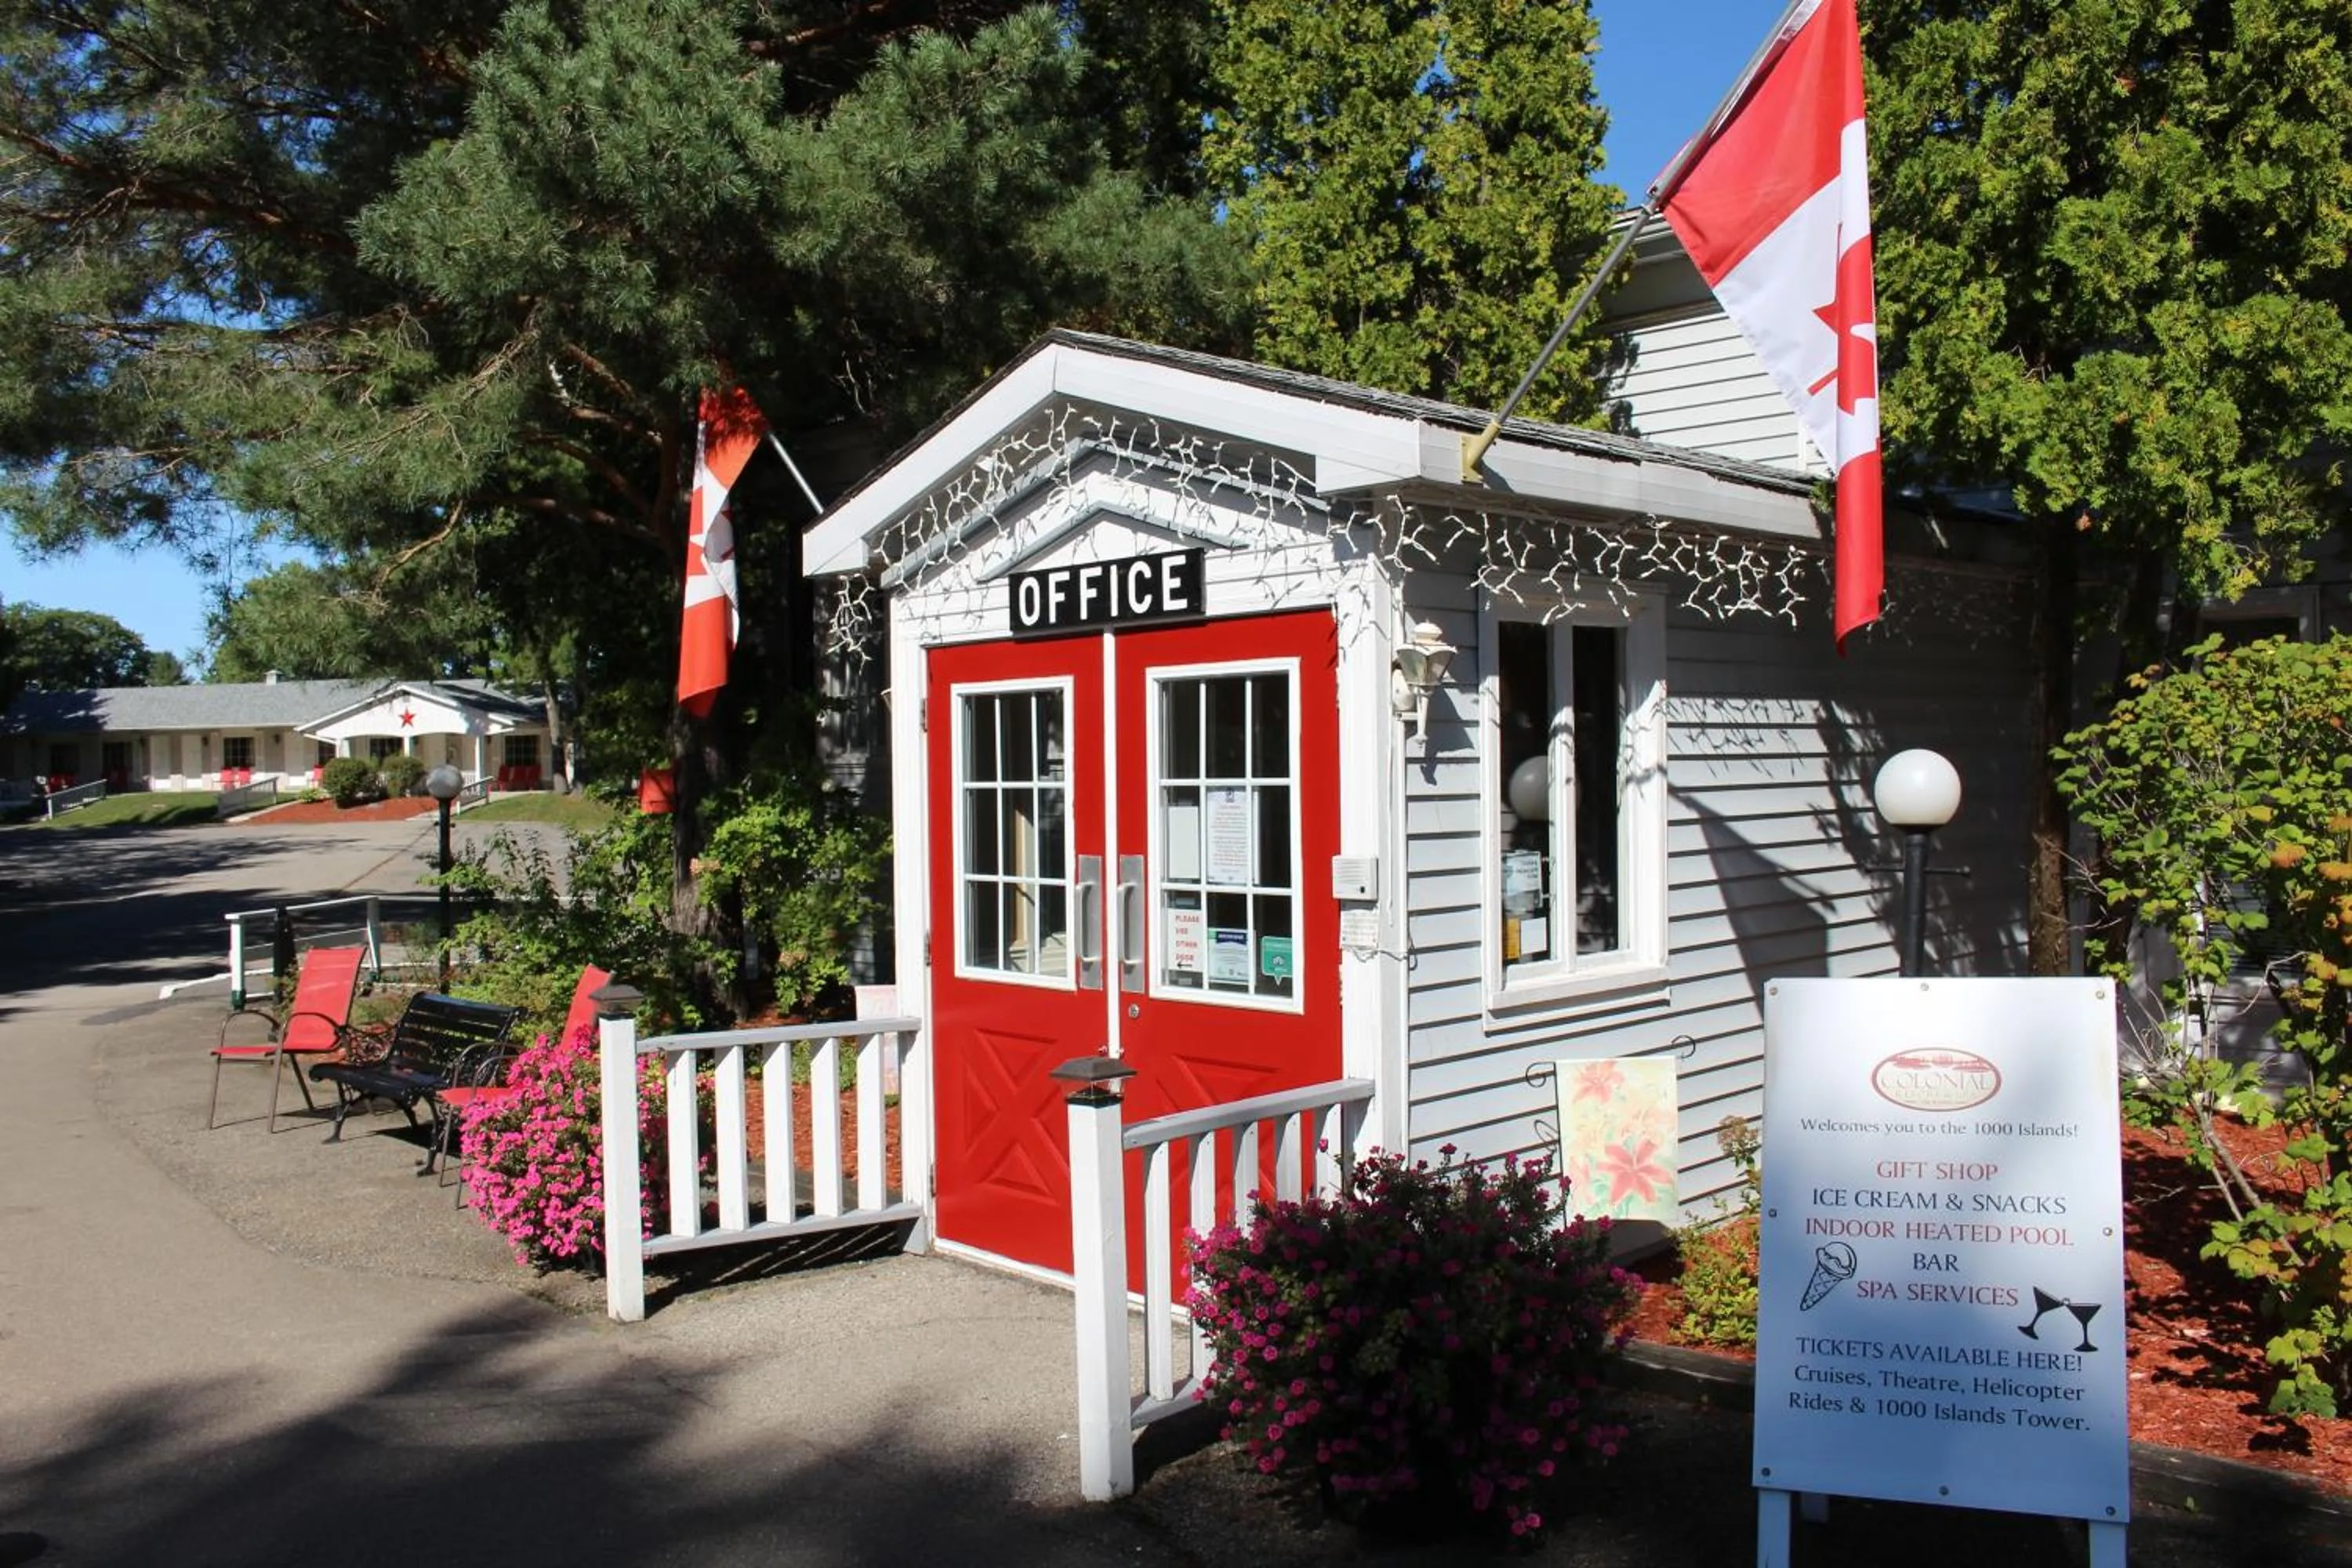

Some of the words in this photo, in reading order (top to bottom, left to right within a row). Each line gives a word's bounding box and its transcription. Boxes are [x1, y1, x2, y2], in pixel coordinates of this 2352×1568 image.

[1020, 555, 1188, 626] OFFICE
[1882, 1071, 1991, 1091] COLONIAL
[1801, 1118, 1879, 1133] Welcomes
[1884, 1123, 1915, 1136] you
[1919, 1123, 1936, 1134] to
[1940, 1121, 1967, 1135] the
[1975, 1123, 2013, 1136] 1000
[2019, 1123, 2078, 1137] Islands!
[1877, 1161, 1927, 1179] GIFT
[1936, 1163, 1998, 1181] SHOP
[1813, 1189, 1847, 1207] ICE
[1855, 1190, 1937, 1210] CREAM
[1946, 1193, 1963, 1211] &
[1973, 1194, 2067, 1214] SNACKS
[1806, 1218, 1895, 1239] INDOOR
[1906, 1222, 2002, 1243] HEATED
[2010, 1226, 2074, 1246] POOL
[1913, 1253, 1960, 1271] BAR
[1857, 1280, 1898, 1299] SPA
[1907, 1283, 2019, 1306] SERVICES
[1796, 1337, 1883, 1358] TICKETS
[1889, 1344, 2009, 1367] AVAILABLE
[2017, 1352, 2082, 1371] HERE!
[1795, 1365, 1871, 1388] Cruises,
[1973, 1377, 2086, 1403] Helicopter
[1789, 1392, 1843, 1412] Rides
[1849, 1396, 1866, 1414] &
[1876, 1399, 1926, 1418] 1000
[1935, 1403, 2006, 1425] Islands
[2013, 1409, 2090, 1431] Tower.
